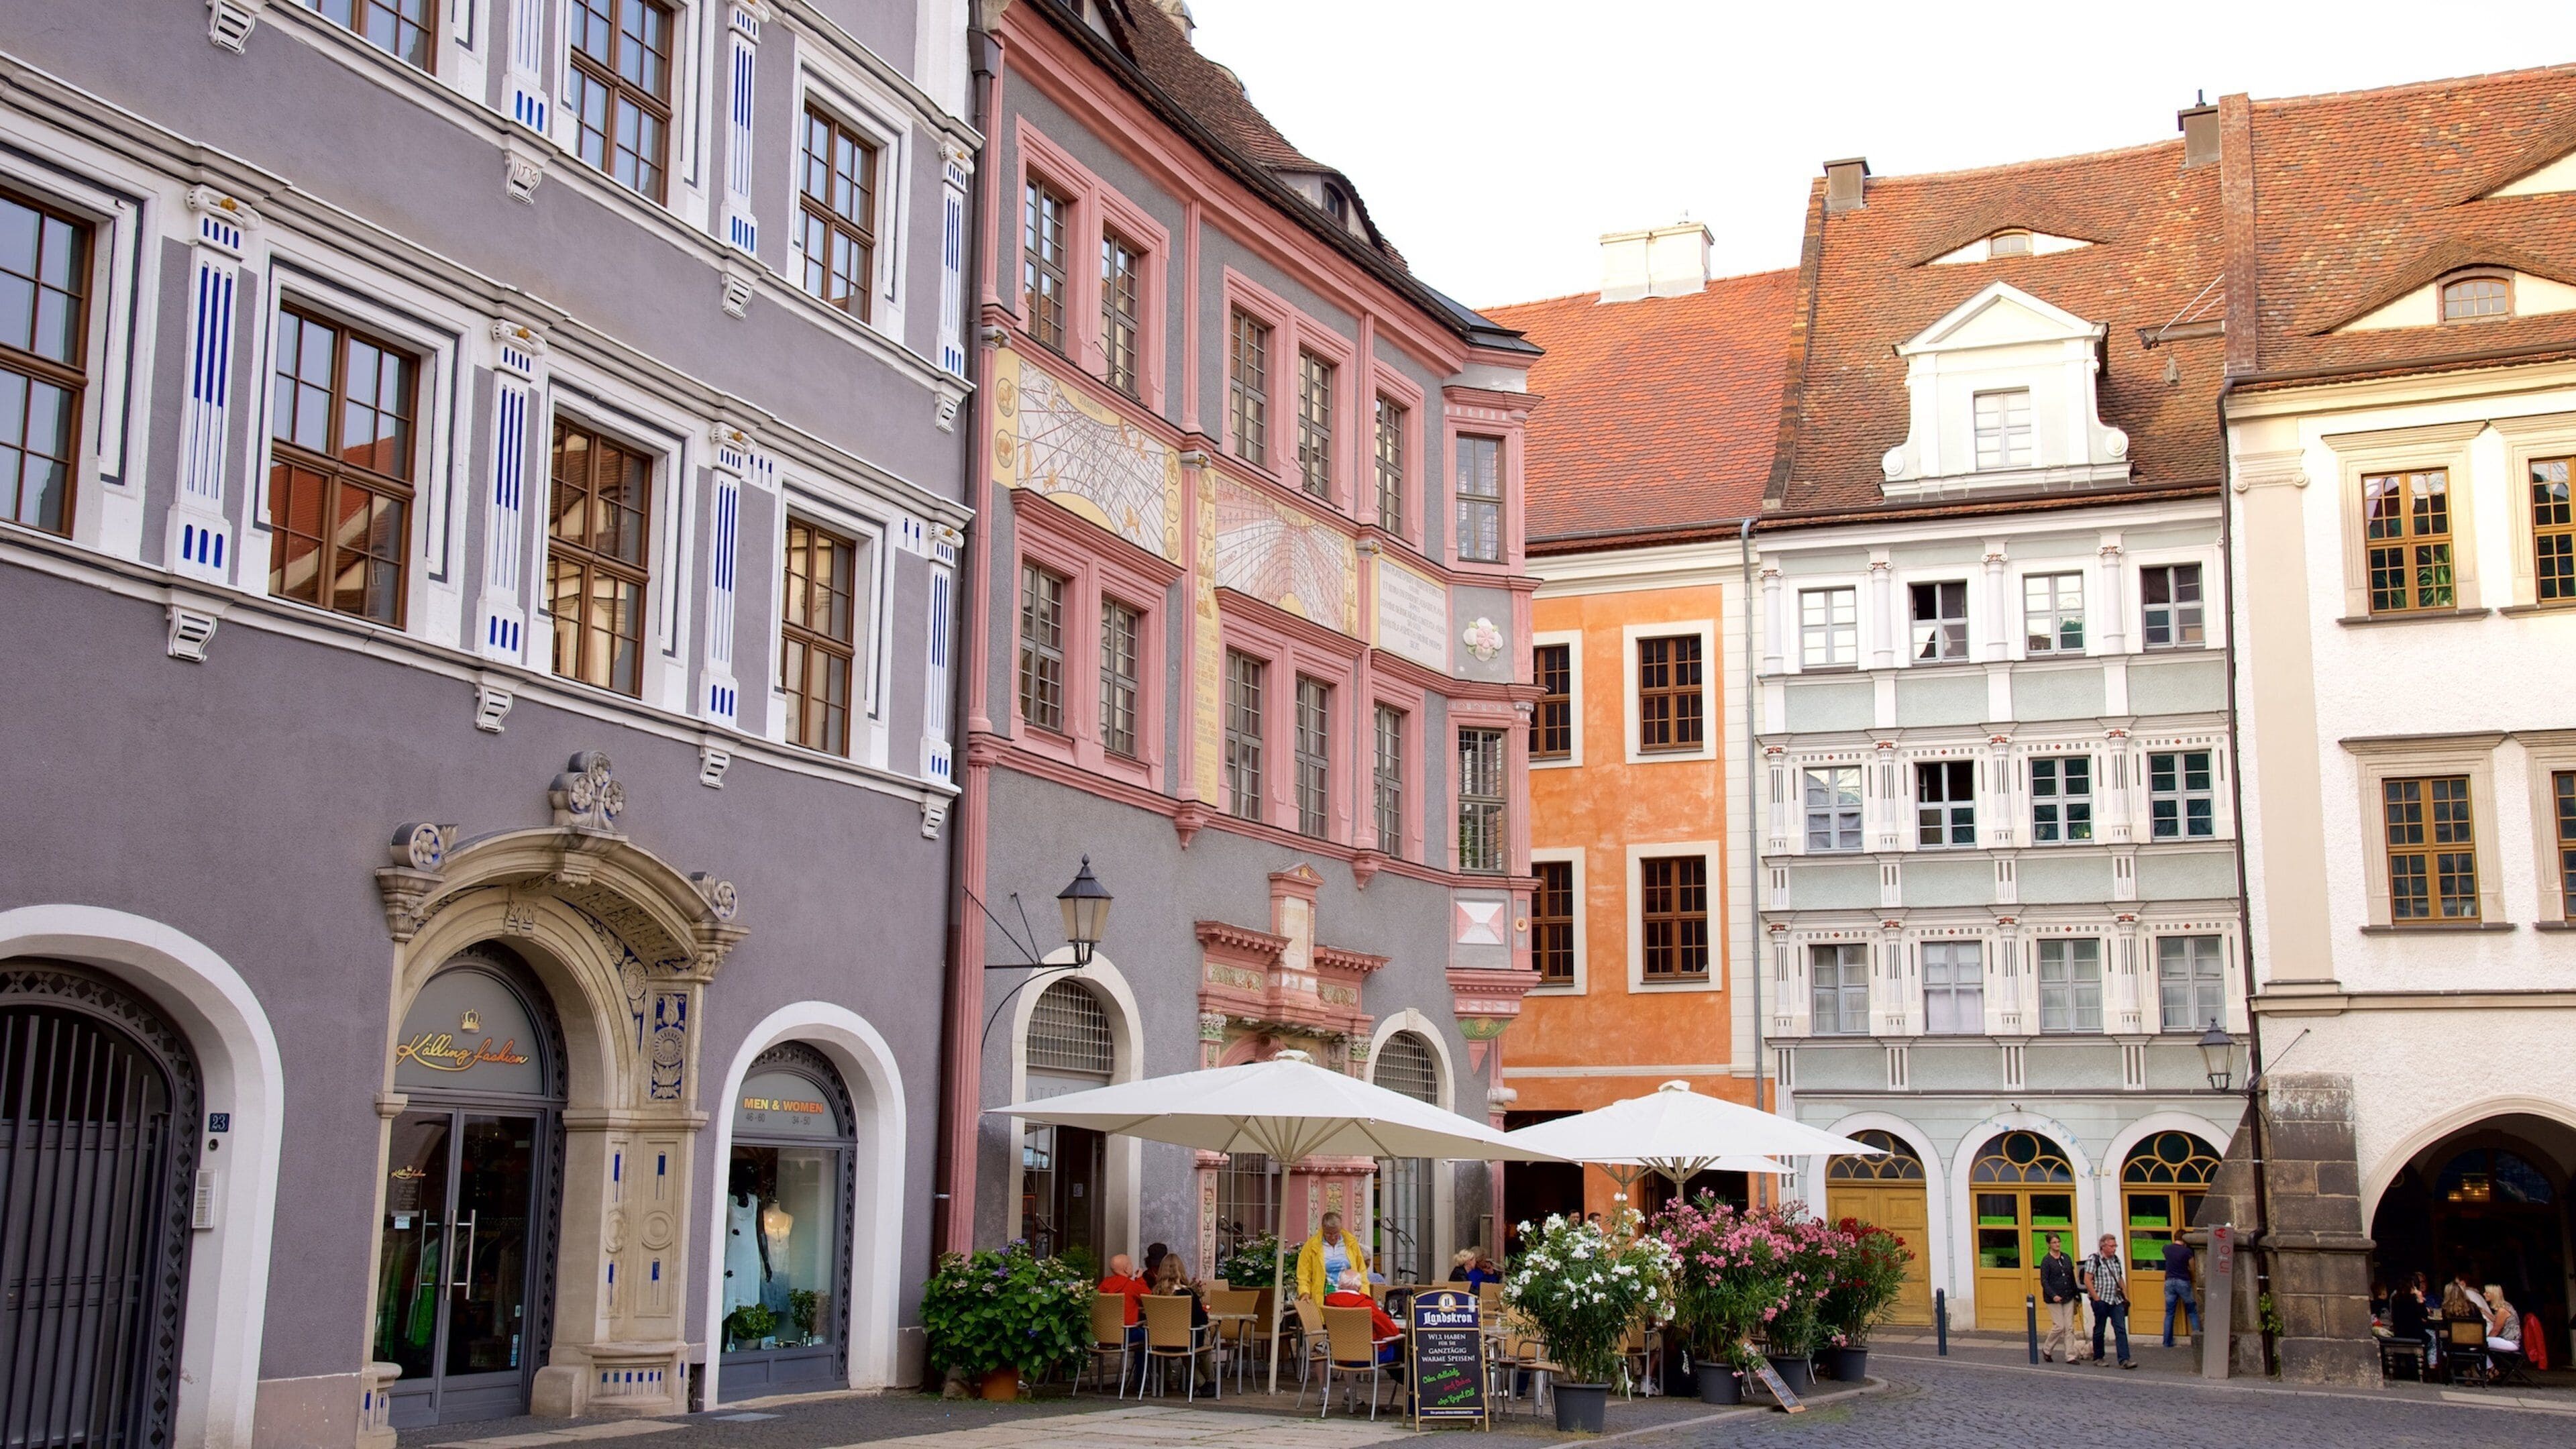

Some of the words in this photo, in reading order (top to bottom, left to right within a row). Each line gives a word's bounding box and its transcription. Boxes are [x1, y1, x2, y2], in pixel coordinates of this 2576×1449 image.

[396, 1033, 472, 1071] Källing
[473, 1037, 529, 1065] fashion
[744, 1098, 769, 1110] MEN
[771, 1099, 780, 1112] &
[782, 1100, 824, 1114] WOMEN
[212, 1115, 225, 1130] 23
[2216, 1245, 2231, 1273] info
[1423, 1311, 1472, 1326] Landskron
